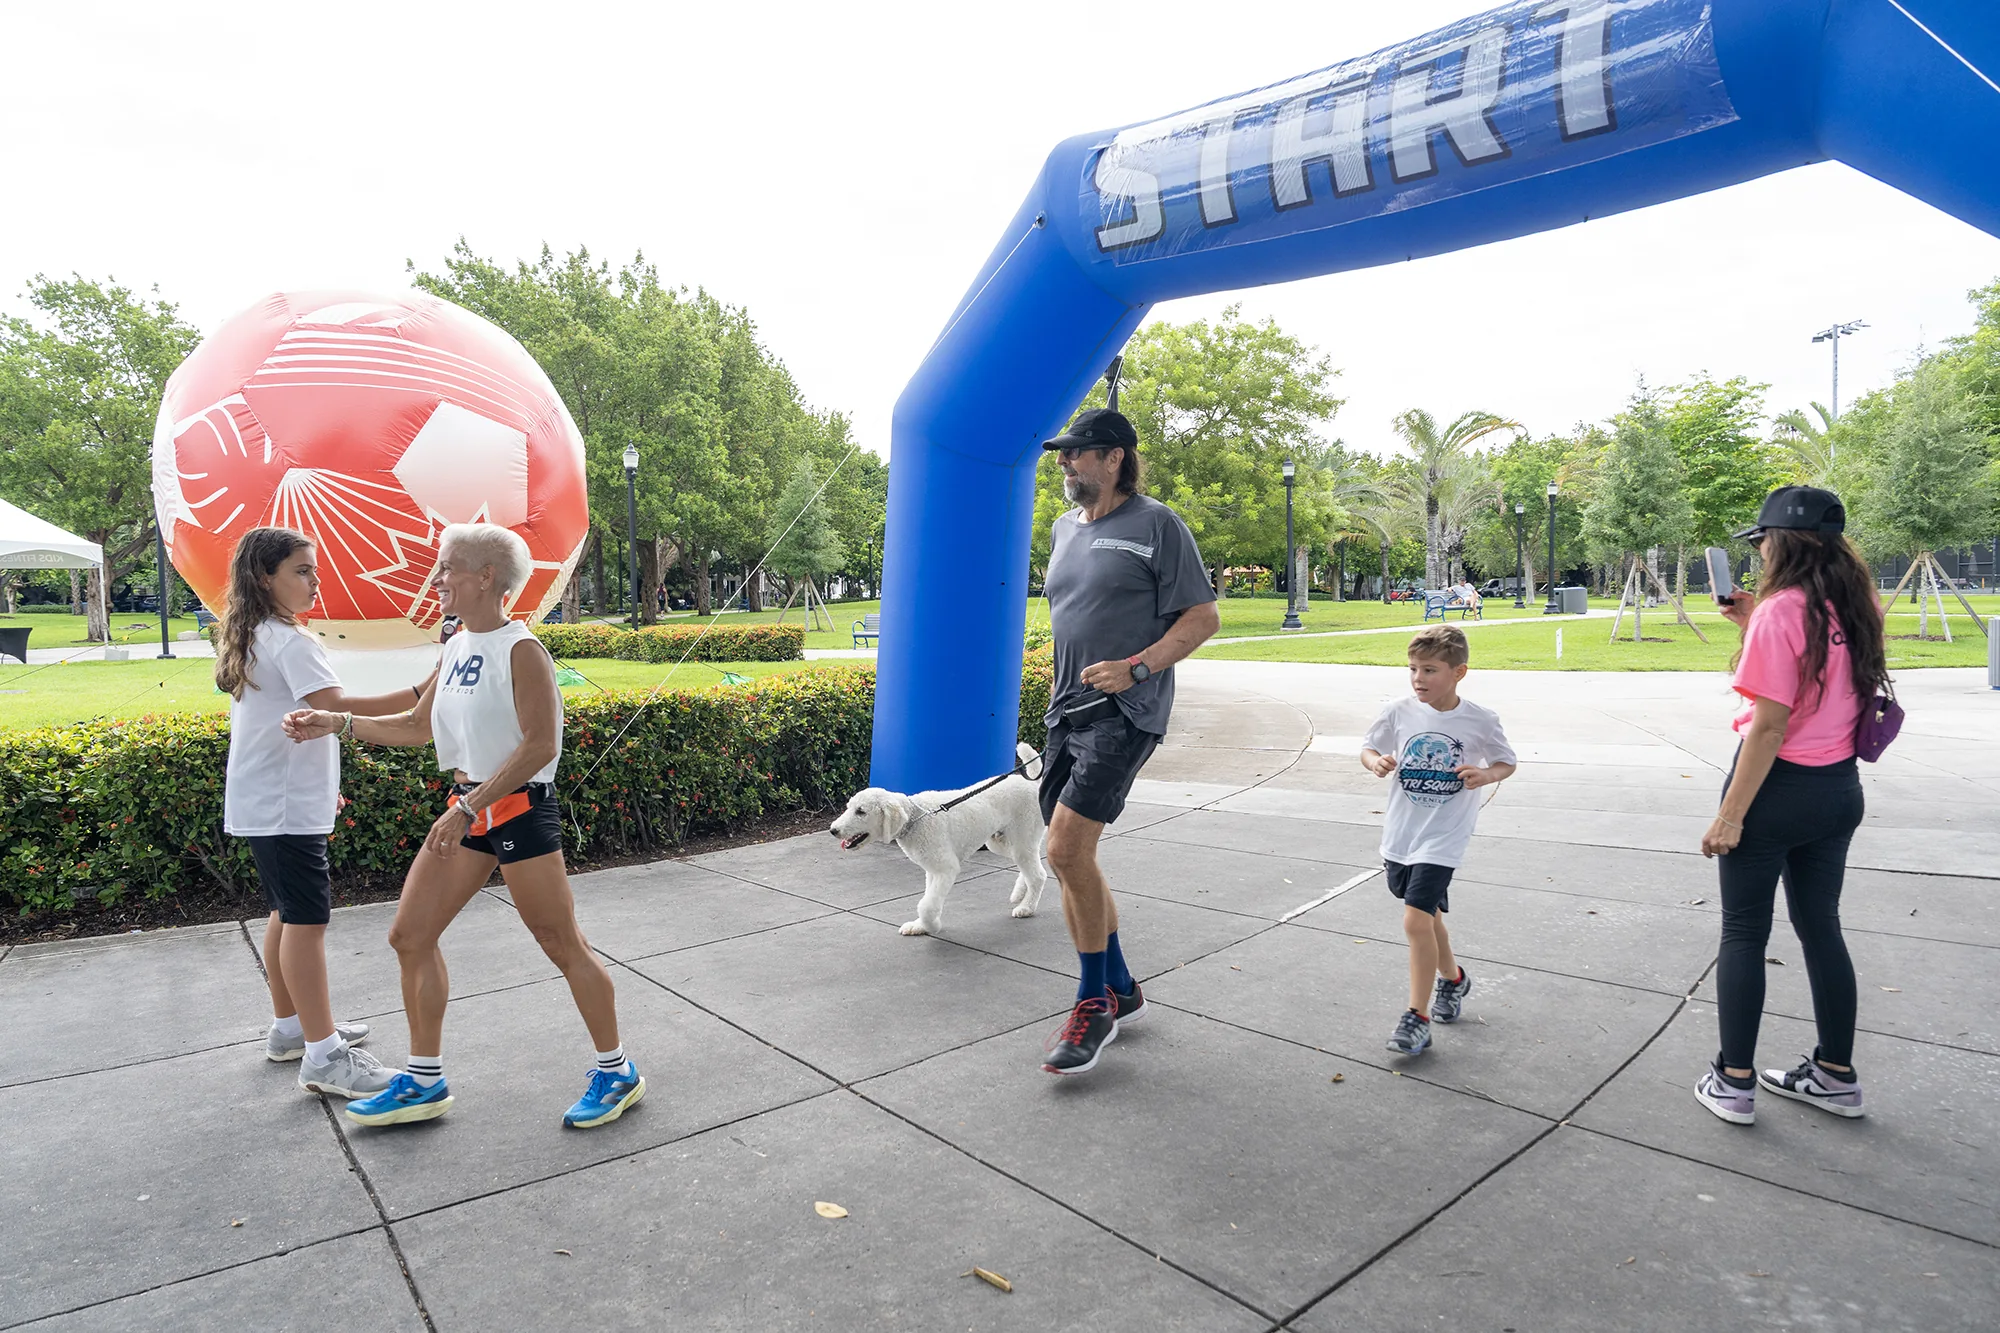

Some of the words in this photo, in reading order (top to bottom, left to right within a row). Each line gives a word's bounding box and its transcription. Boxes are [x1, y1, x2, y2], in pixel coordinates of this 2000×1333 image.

[1093, 0, 1619, 252] START
[445, 655, 484, 686] MB
[1401, 770, 1432, 779] SOUTH
[1403, 779, 1422, 788] TRI
[1422, 779, 1462, 791] SQUAD
